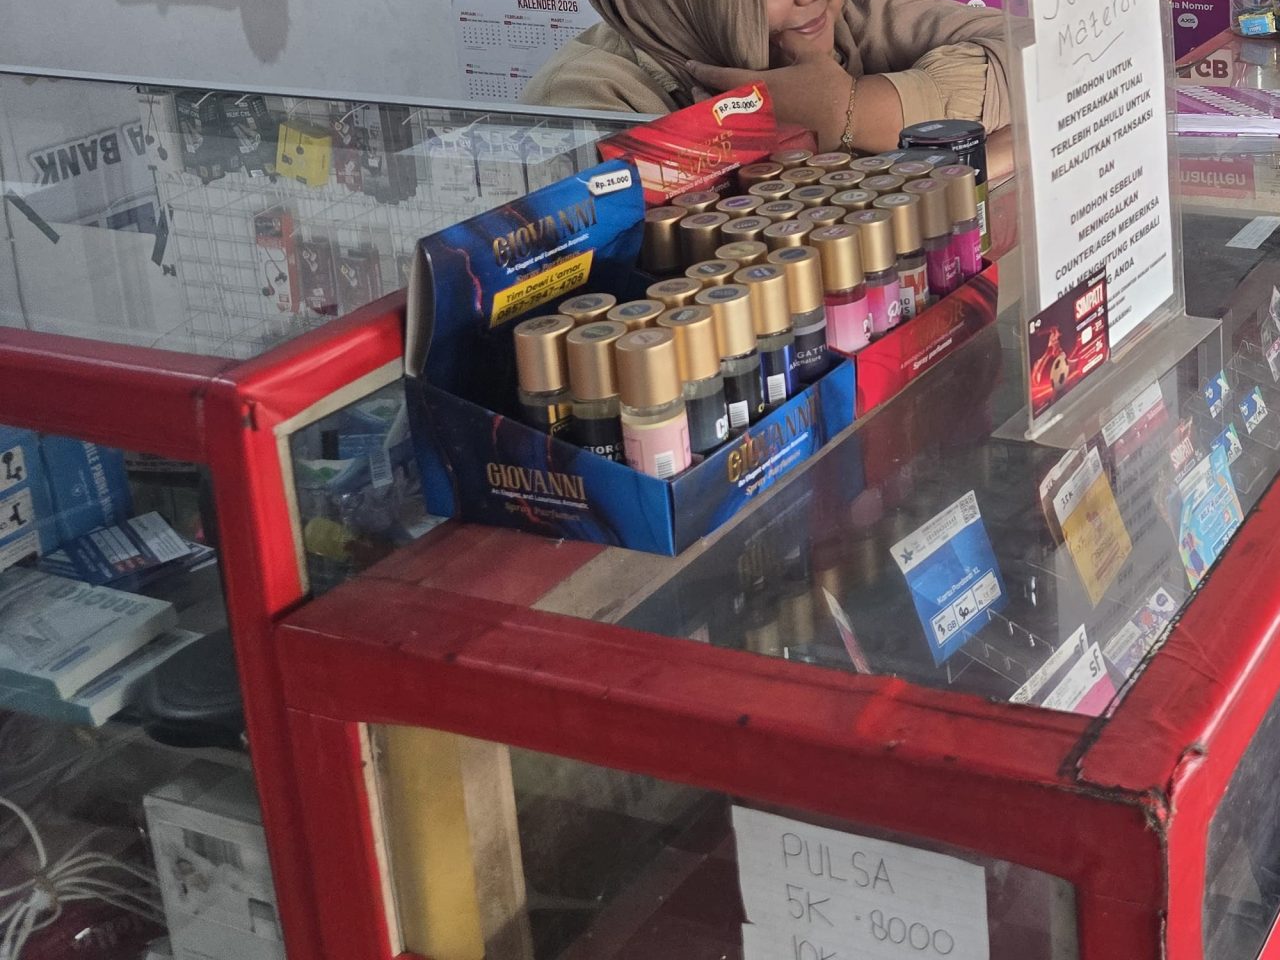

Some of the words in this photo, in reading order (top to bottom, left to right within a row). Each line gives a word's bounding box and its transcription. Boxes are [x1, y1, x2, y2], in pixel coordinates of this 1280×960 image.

[558, 0, 578, 12] 2026
[1182, 1, 1214, 11] Nomor
[1057, 88, 1119, 131] MENYERAHKAN
[1120, 73, 1143, 93] TUNAI
[1066, 75, 1105, 103] DIMOHON
[1106, 58, 1133, 80] UNTUK
[1050, 128, 1091, 158] TERLEBIH
[1093, 108, 1124, 134] DAHULU
[1126, 89, 1151, 112] UNTUK
[1051, 136, 1111, 182] MELANJUTKAN
[1113, 108, 1153, 143] TRANSAKSI
[1099, 160, 1115, 178] DAN
[1070, 194, 1108, 225] DIMOHON
[1109, 166, 1143, 200] SEBELUM
[1078, 190, 1139, 242] MENINGGALKAN
[1118, 196, 1159, 234] MEMERIKSA
[493, 197, 597, 267] GIOVANNI
[1129, 216, 1160, 246] KEMBALI
[1114, 258, 1134, 278] ANDA
[507, 290, 524, 303] Tim
[526, 279, 549, 293] Dewi
[487, 463, 586, 500] GIOVANNI
[781, 833, 894, 894] PULSA
[786, 884, 833, 927] 5K
